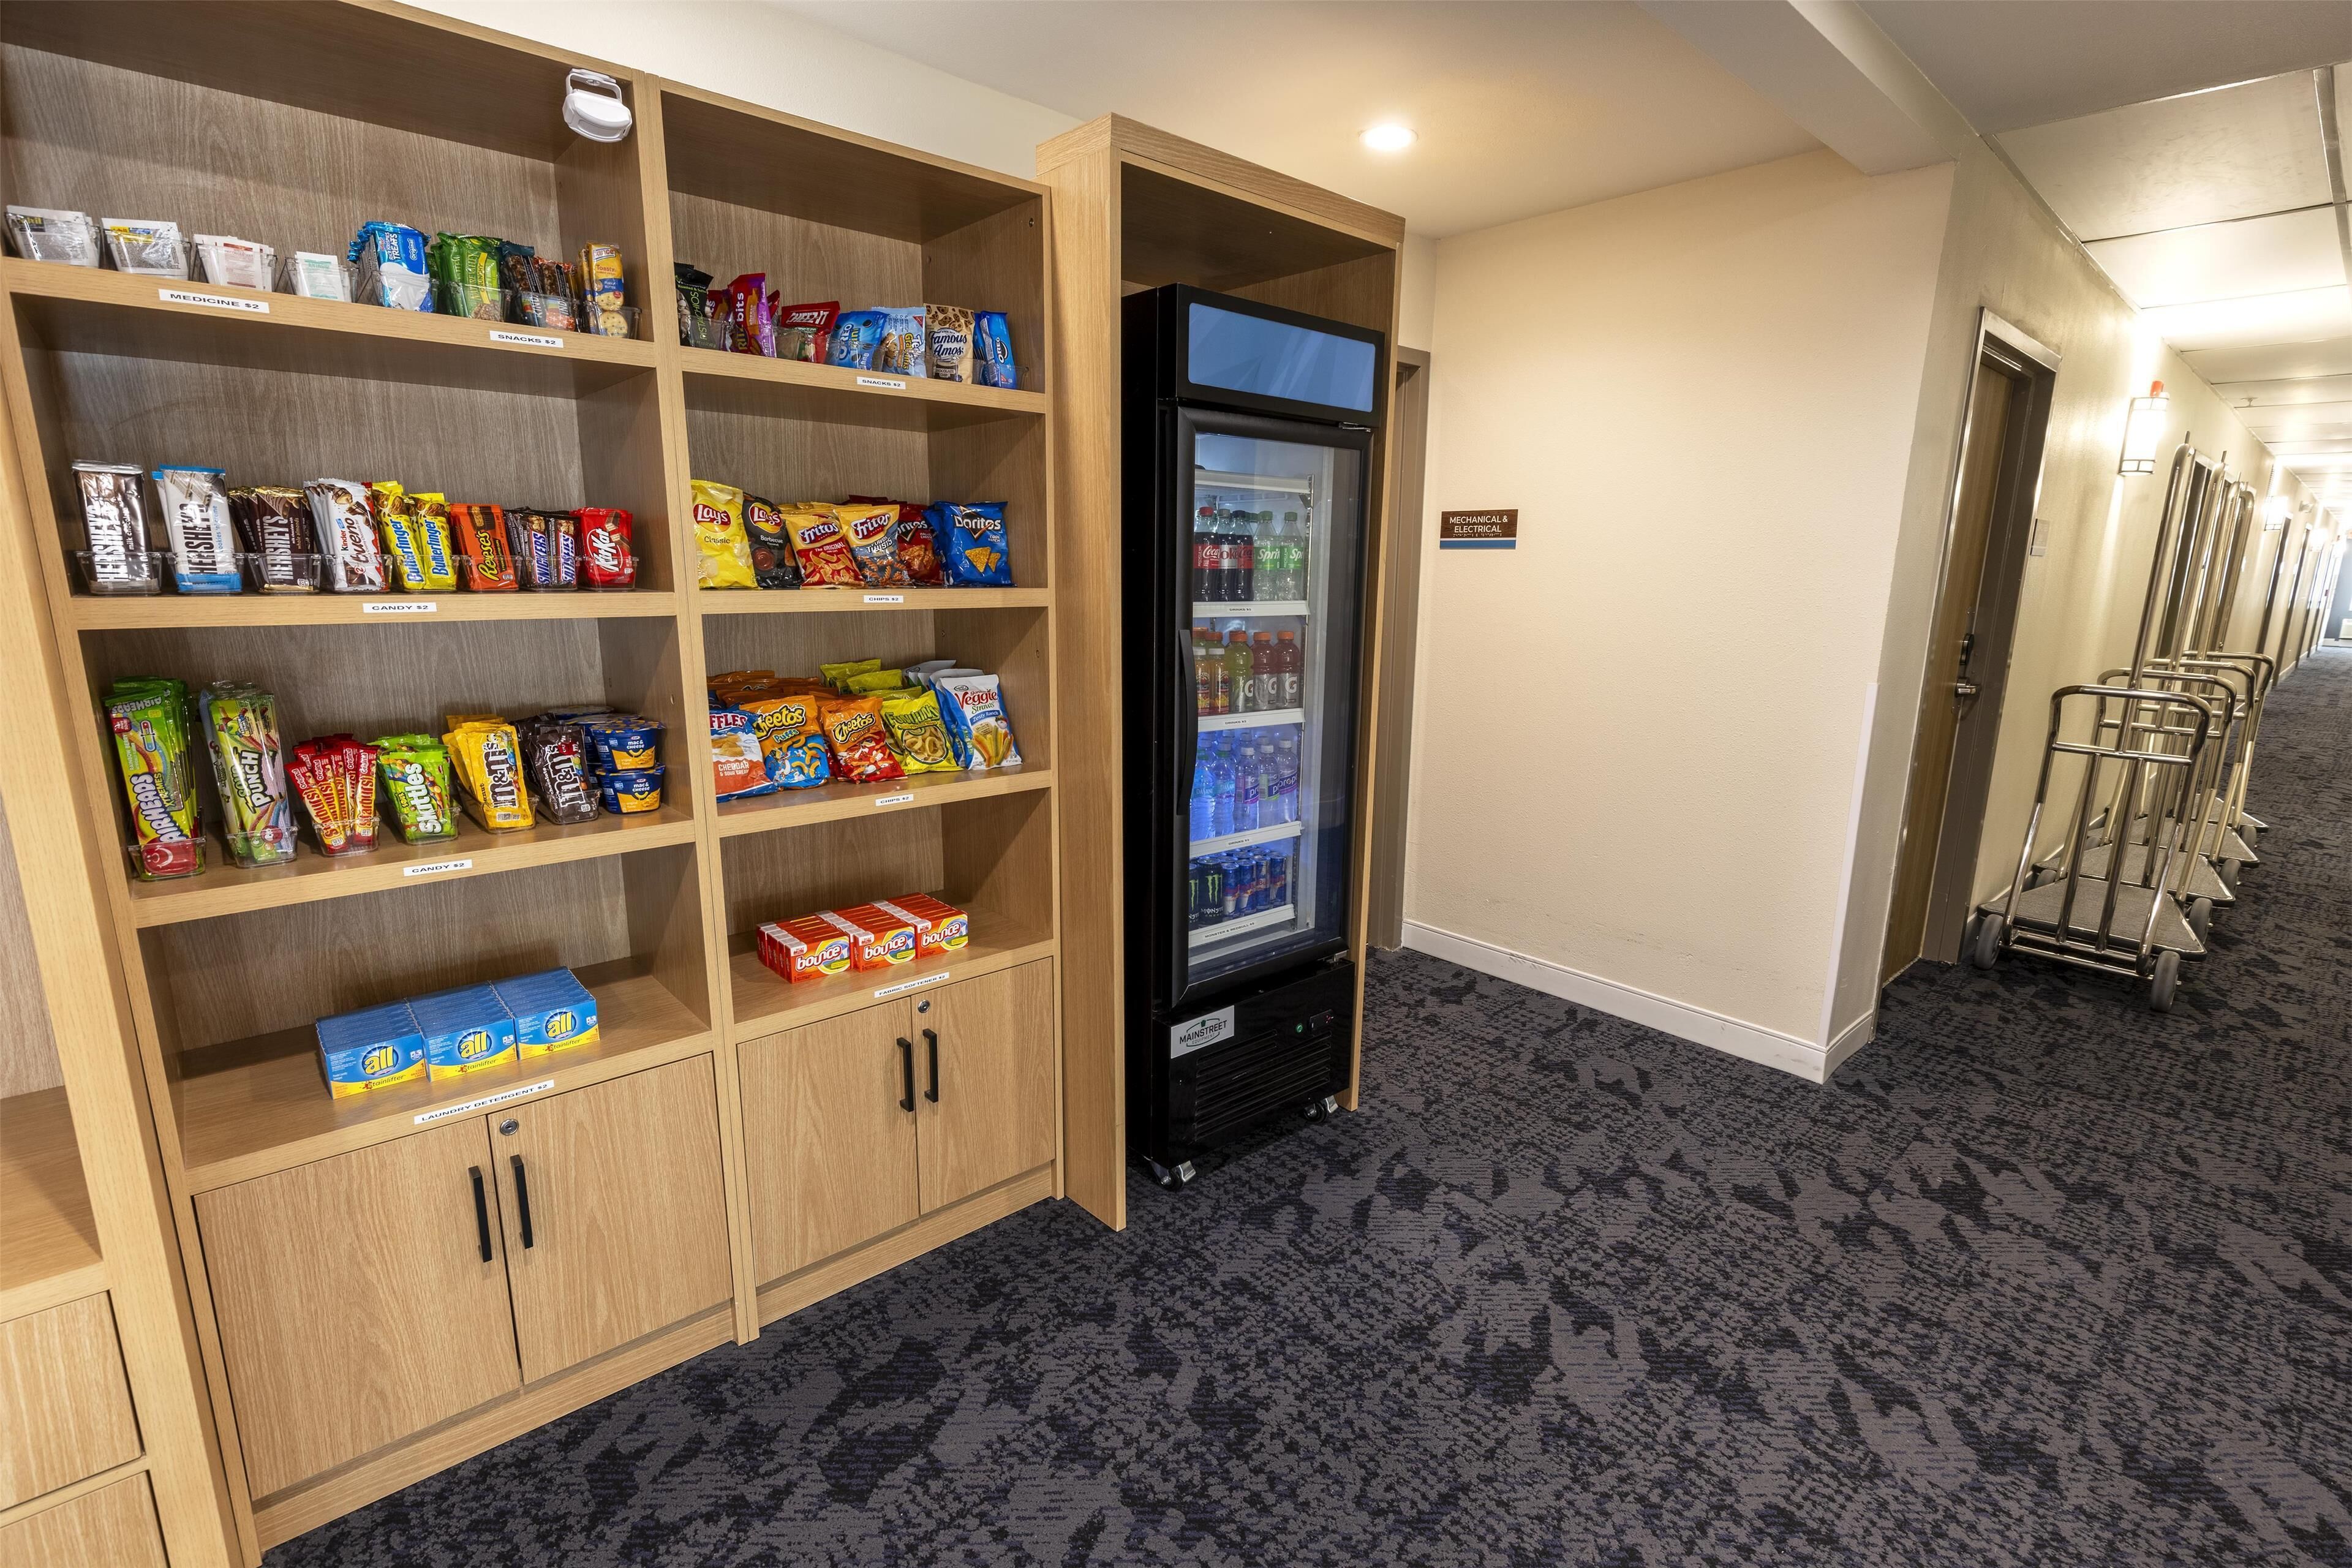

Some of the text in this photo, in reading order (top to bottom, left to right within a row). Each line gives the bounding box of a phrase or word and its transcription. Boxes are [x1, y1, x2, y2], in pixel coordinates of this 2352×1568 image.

[390, 233, 402, 261] TREATS
[596, 264, 616, 273] Toasty
[170, 293, 239, 307] MEDICINE
[736, 292, 744, 322] bits
[690, 291, 707, 340] PISTACHIOS
[786, 310, 831, 325] CHEEZ-IT
[497, 334, 541, 344] SNACKS
[930, 331, 968, 344] Famous
[933, 344, 962, 356] Amos
[696, 504, 728, 525] Lay's
[753, 507, 780, 526] Lay's
[954, 514, 1001, 530] Doritos
[1449, 515, 1502, 524] MECHANICAL
[797, 522, 839, 545] Fritos
[851, 513, 891, 540] Fritos
[263, 516, 294, 580] HERSHEY'S
[345, 517, 369, 564] bueno
[424, 519, 450, 576] Butterfinger
[704, 536, 731, 545] Classic
[760, 535, 783, 544] Barbecue
[823, 541, 846, 551] ORIGINAL
[866, 538, 893, 554] TWISTS
[478, 530, 500, 581] Reese's
[533, 533, 550, 584] SNICKERS
[111, 696, 162, 714] AIRHEADS
[954, 690, 998, 710] Veggie
[971, 703, 995, 715] Straws
[709, 714, 747, 730] FFLES
[753, 706, 805, 740] Cheetos
[885, 704, 940, 728] FUNYUNS
[973, 714, 986, 723] Zesty
[774, 729, 799, 743] Puffs
[833, 713, 875, 742] Cheetos
[314, 760, 323, 780] Original
[718, 761, 750, 772] CHEDDAR
[240, 751, 276, 807] PUNCH
[292, 769, 306, 789] Original
[153, 772, 176, 807] XTREMES
[404, 763, 442, 834] Skittles
[130, 774, 186, 842] AIRHEADS
[398, 792, 409, 808] SOUR
[412, 864, 450, 873] CANDY
[921, 923, 961, 947] bounce
[1205, 929, 1226, 938] MONSTER
[796, 945, 842, 971] bounce
[864, 936, 907, 960] bounce
[903, 978, 937, 989] SOFTENER
[547, 1011, 573, 1037] all
[1179, 1019, 1228, 1044] MAINSTREET
[460, 1030, 488, 1058] all
[1192, 1033, 1215, 1044] EQUIPMENT
[364, 1044, 394, 1075] all
[421, 1105, 471, 1121] LAUNDRY
[473, 1087, 534, 1107] DETERGENT
